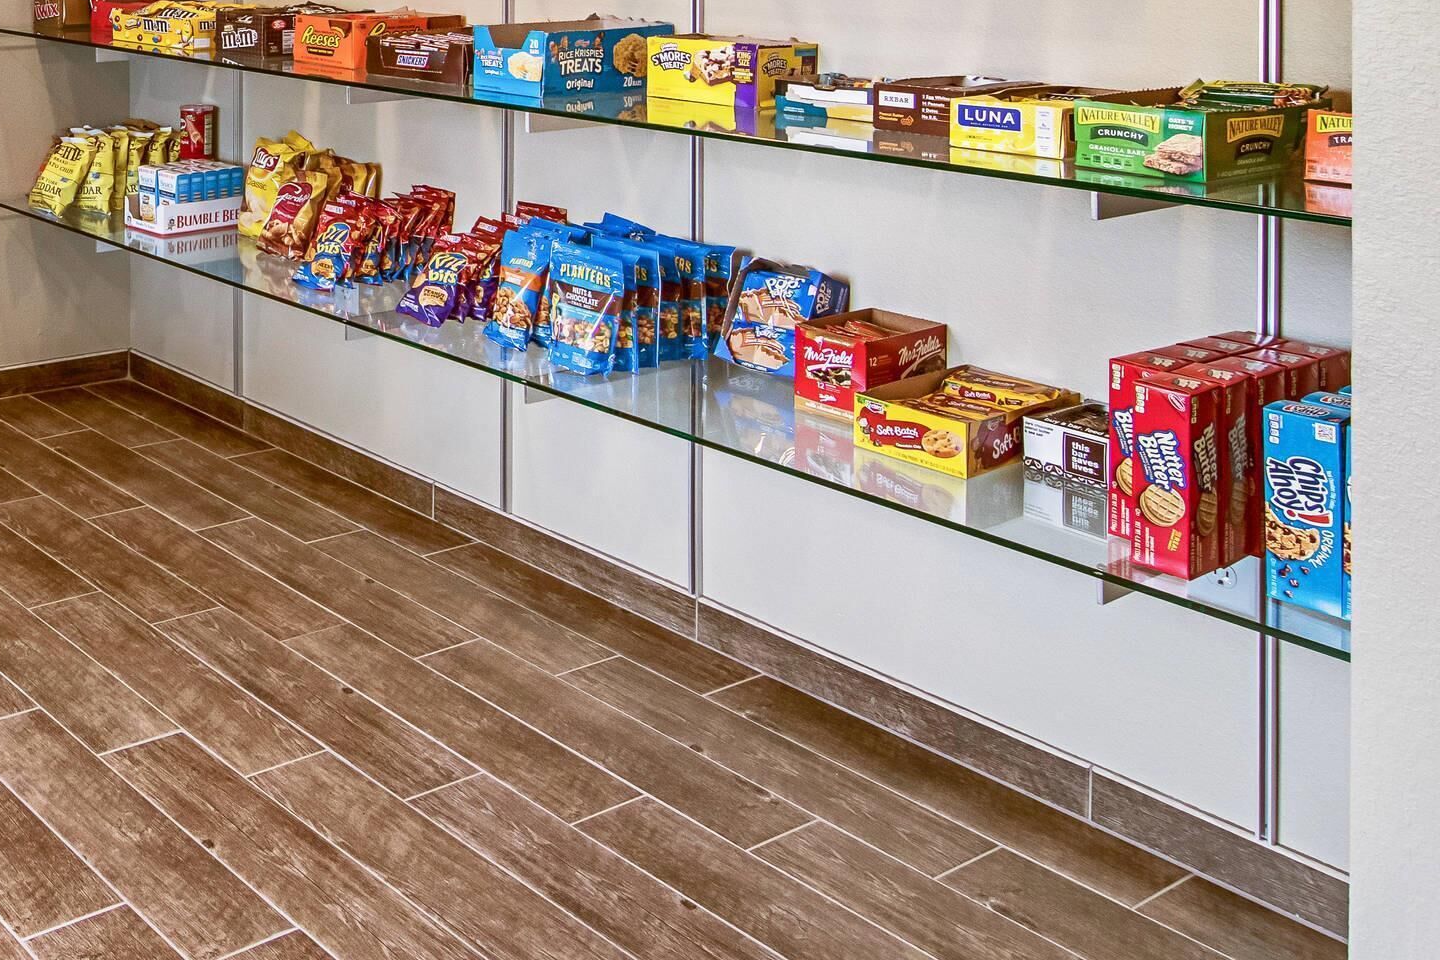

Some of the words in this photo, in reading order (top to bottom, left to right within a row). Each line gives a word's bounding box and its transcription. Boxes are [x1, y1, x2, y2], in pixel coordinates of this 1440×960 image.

[34, 0, 60, 20] Twix
[301, 26, 340, 47] Reese's
[529, 39, 539, 49] 20
[397, 55, 428, 66] SNICKERS
[559, 51, 574, 61] RICE
[575, 48, 604, 58] KRISPIES
[651, 51, 691, 66] S'MORES
[737, 52, 751, 60] KING
[481, 60, 503, 68] TREATS
[560, 59, 602, 75] TREATS
[661, 62, 684, 70] TREATS
[566, 79, 594, 90] original
[623, 76, 632, 87] 20
[964, 109, 1015, 125] LUNA
[1081, 108, 1120, 123] NATURE
[1121, 113, 1157, 130] VALLEY
[1229, 119, 1258, 137] NATURE
[1259, 117, 1282, 134] VALLEY
[1098, 128, 1144, 140] CRUNCHY
[1089, 144, 1125, 154] GRANOLA
[1127, 149, 1146, 157] BARS
[1240, 141, 1271, 153] CRUNCHY
[176, 211, 220, 229] BUMBLE
[222, 208, 240, 222] BEE
[429, 270, 457, 283] bits
[560, 263, 611, 288] PLANTERS
[572, 287, 587, 297] NUTS
[587, 290, 592, 298] &
[566, 292, 599, 307] CHOCOLATE
[869, 357, 877, 367] 12
[817, 381, 825, 389] 12
[876, 424, 895, 436] Soft
[895, 426, 919, 438] Batch
[992, 433, 1014, 459] Soft
[1071, 441, 1090, 452] this
[1203, 424, 1217, 481] Nutter
[1071, 449, 1088, 458] bar
[1155, 431, 1185, 487] Nutter
[1072, 456, 1099, 468] saves
[1138, 435, 1170, 490] Butter
[1194, 436, 1211, 492] Butter
[1289, 459, 1327, 514] Chips
[1310, 530, 1335, 568] ORIGINAL
